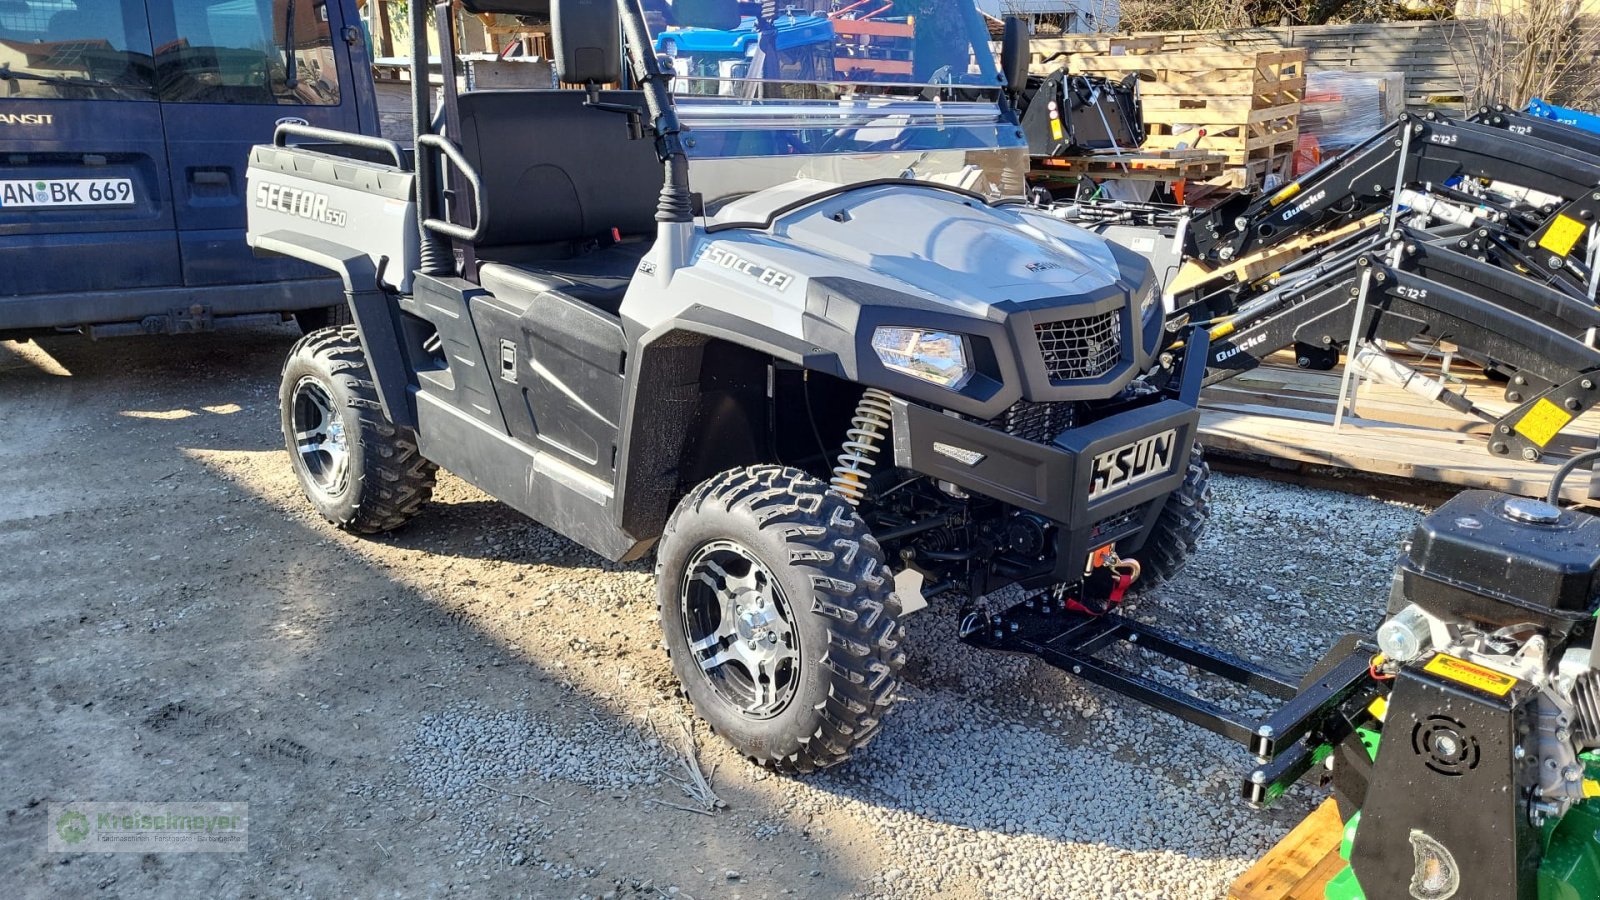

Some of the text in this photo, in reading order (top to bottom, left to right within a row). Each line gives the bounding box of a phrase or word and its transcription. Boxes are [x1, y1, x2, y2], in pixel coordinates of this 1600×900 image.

[3, 182, 130, 203] AN BK 669
[256, 182, 328, 222] SECTOR
[1282, 189, 1326, 221] Quicke
[640, 260, 657, 275] EPS
[758, 266, 794, 291] EFI
[1215, 332, 1268, 363] Quicke
